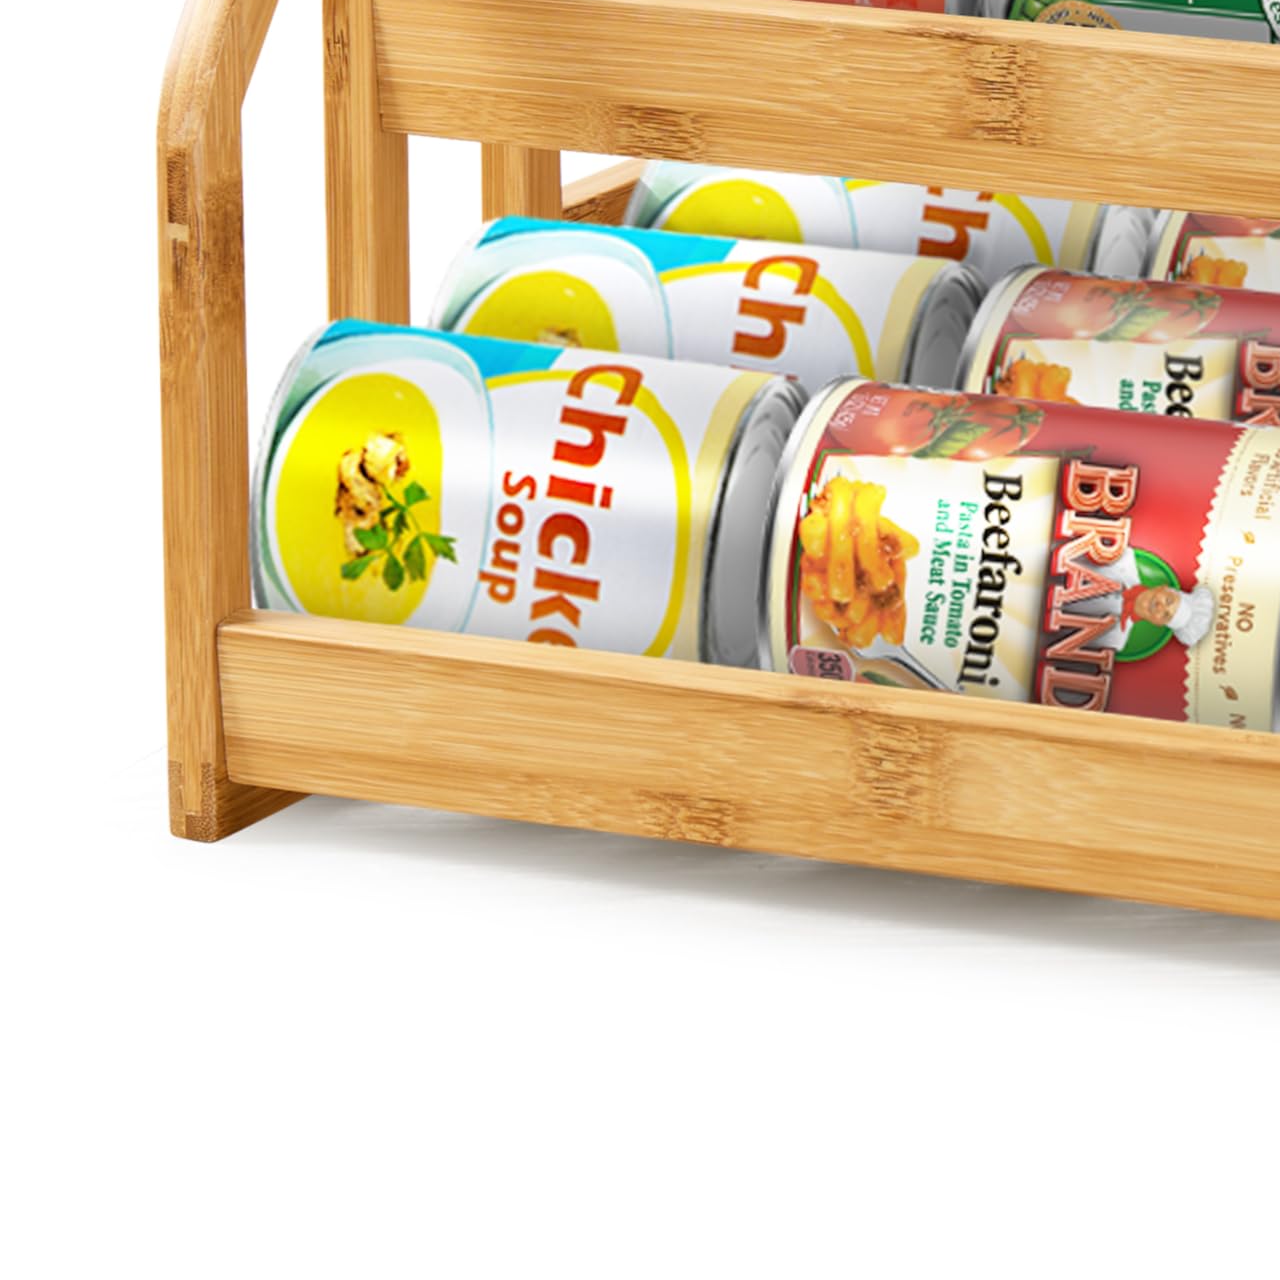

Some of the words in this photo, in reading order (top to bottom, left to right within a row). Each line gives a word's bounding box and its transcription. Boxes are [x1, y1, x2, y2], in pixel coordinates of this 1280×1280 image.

[731, 255, 820, 380] Ch
[1239, 452, 1271, 497] Flavors
[478, 471, 536, 604] Soup
[934, 498, 952, 534] and
[954, 500, 980, 550] Pasta
[928, 536, 952, 587] Meat
[952, 552, 976, 574] in
[957, 470, 1024, 688] Beefaroni
[1033, 459, 1138, 712] BRAND
[920, 590, 947, 646] Sauce
[943, 577, 972, 650] Tomato
[1212, 554, 1244, 676] Preservatives
[1236, 601, 1256, 632] NO
